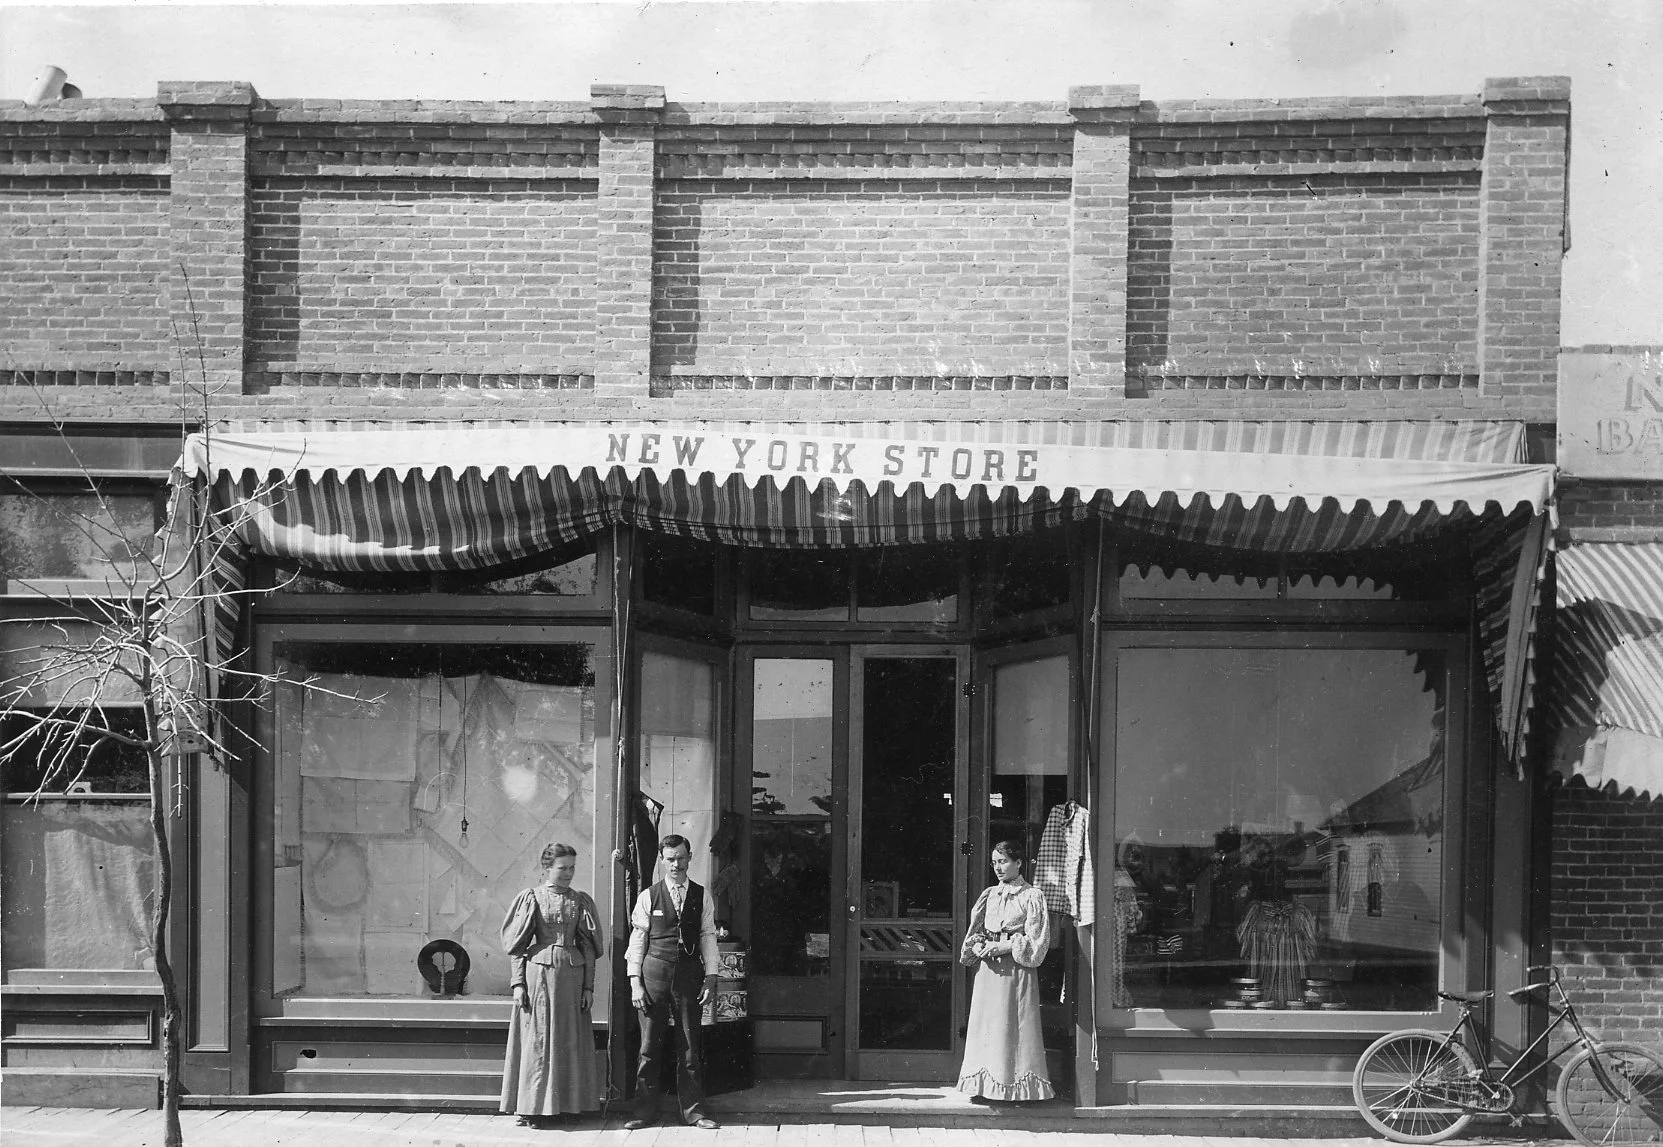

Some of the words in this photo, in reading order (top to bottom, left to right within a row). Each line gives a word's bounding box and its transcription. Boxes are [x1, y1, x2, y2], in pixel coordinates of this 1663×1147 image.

[605, 433, 705, 467] NEW
[732, 438, 856, 474] YORK
[884, 444, 1039, 482] STORE
